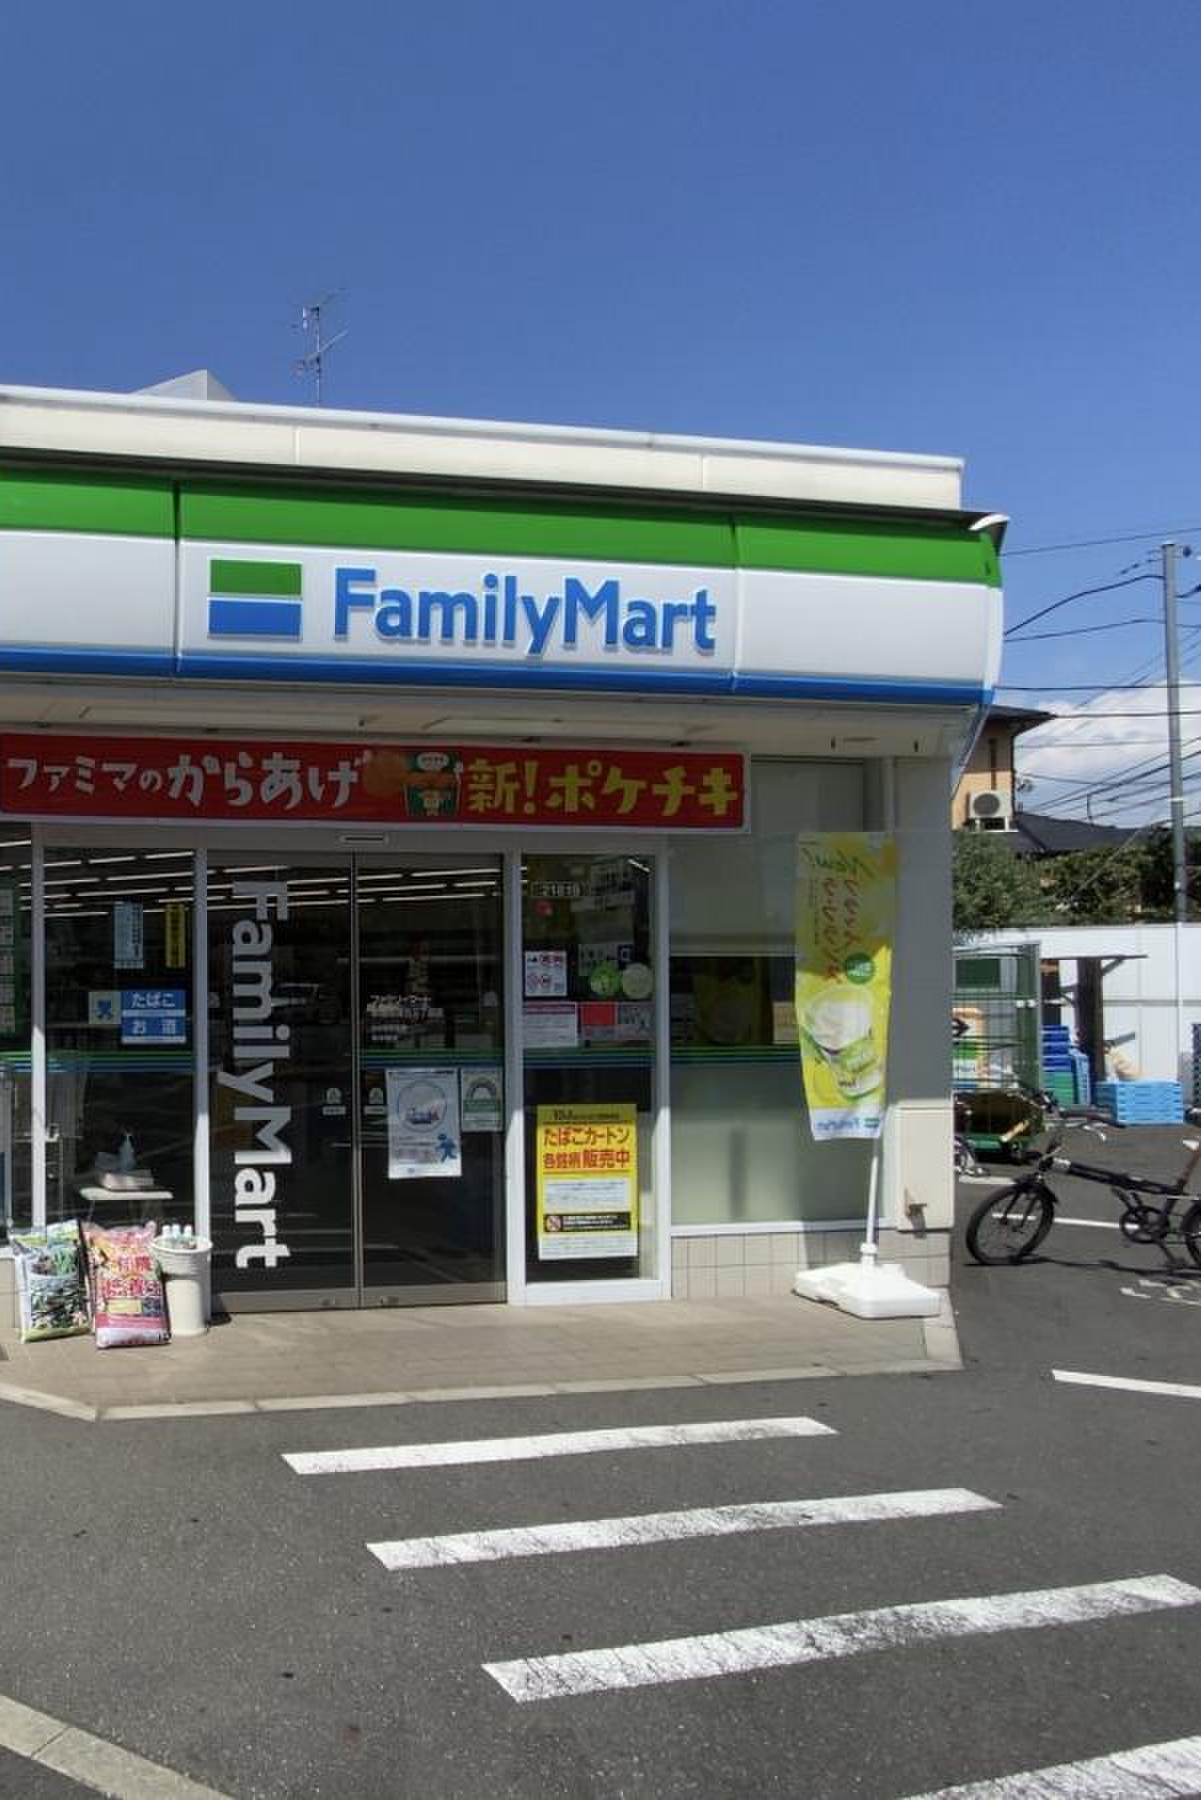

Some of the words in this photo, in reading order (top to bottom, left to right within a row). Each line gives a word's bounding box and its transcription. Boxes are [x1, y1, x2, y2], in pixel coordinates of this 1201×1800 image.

[334, 567, 717, 656] FamilyMart
[7, 750, 372, 810] ファミマのからあげ
[132, 992, 175, 1008] たばこ
[217, 881, 292, 1269] FamilyMart
[543, 1127, 630, 1147] たばこカートン
